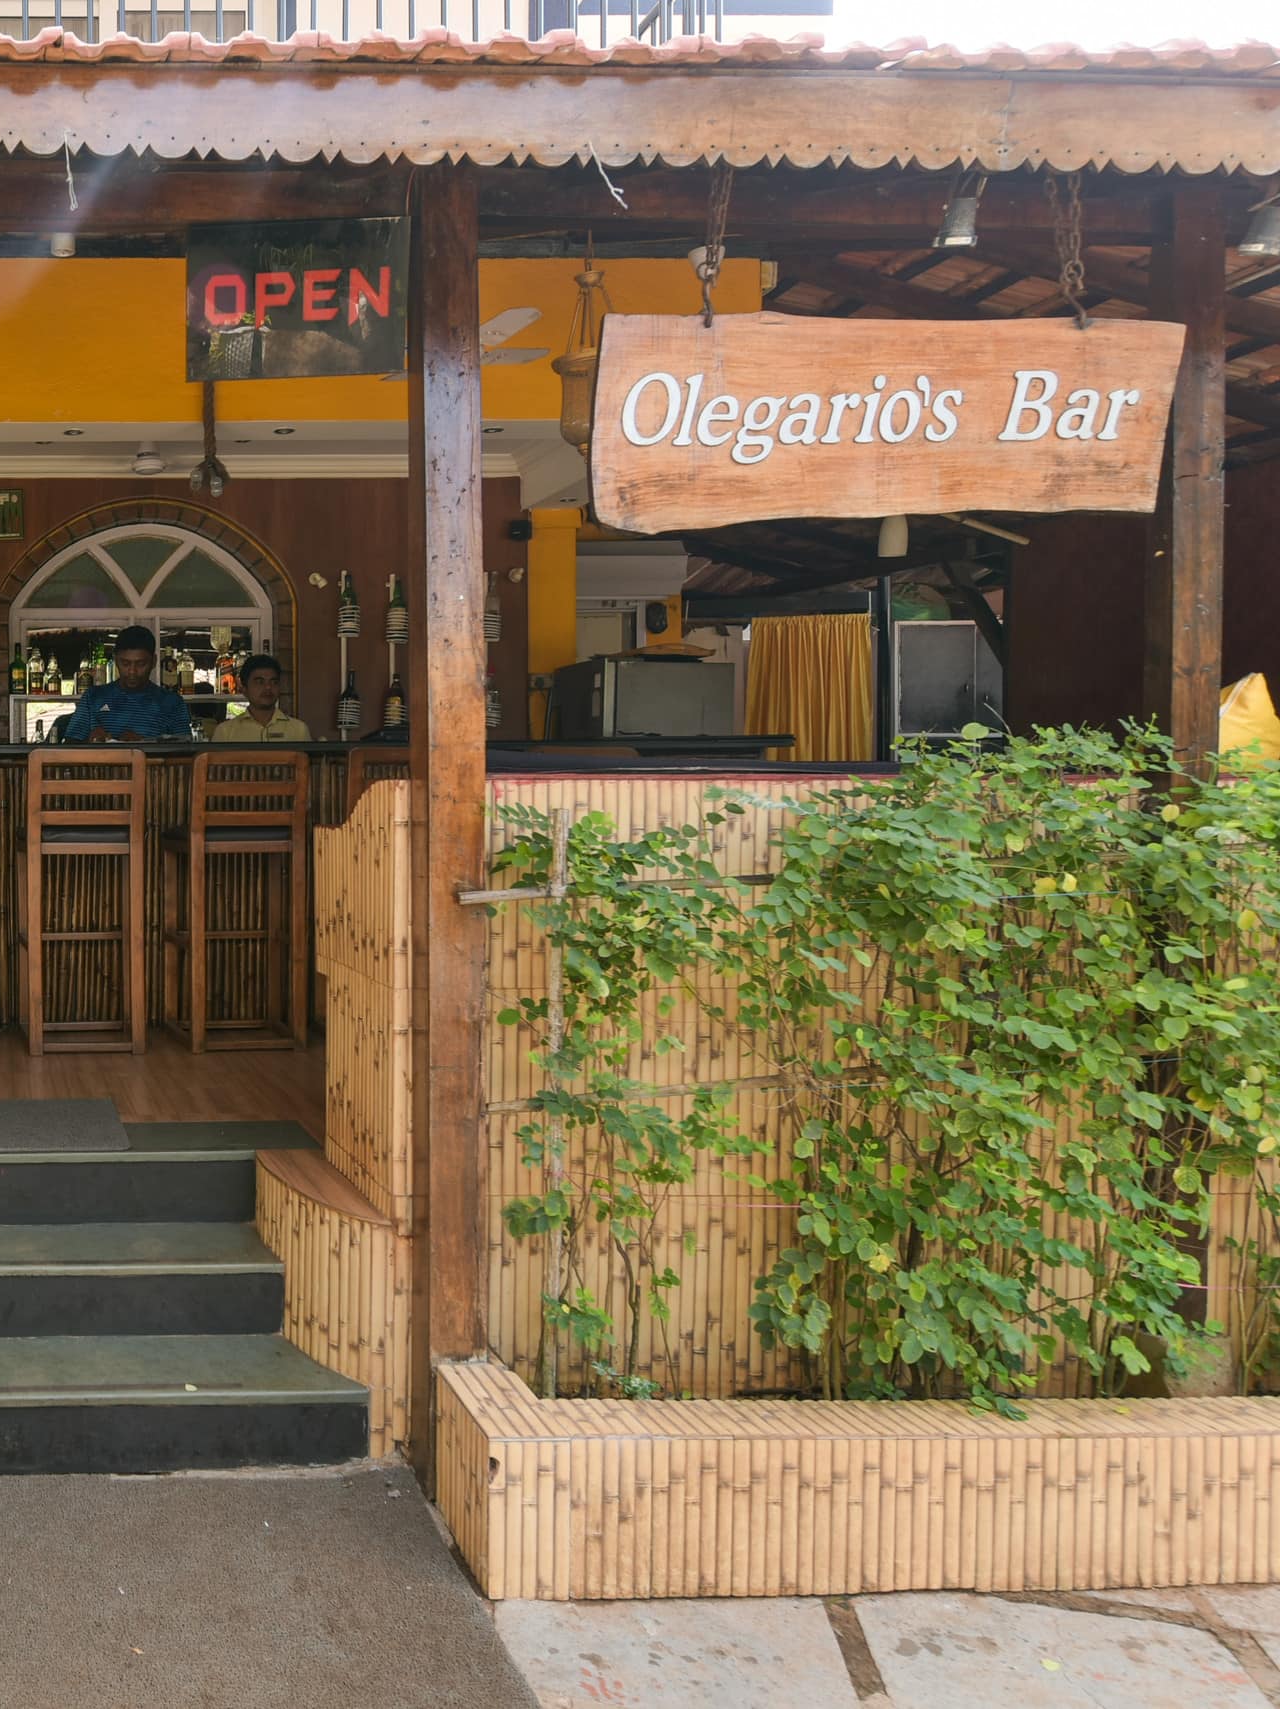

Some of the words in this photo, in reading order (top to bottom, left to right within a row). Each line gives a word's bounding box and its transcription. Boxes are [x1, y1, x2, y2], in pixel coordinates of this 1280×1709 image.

[204, 266, 391, 329] OPEN
[621, 371, 963, 465] Olegario's
[997, 369, 1140, 442] Bar
